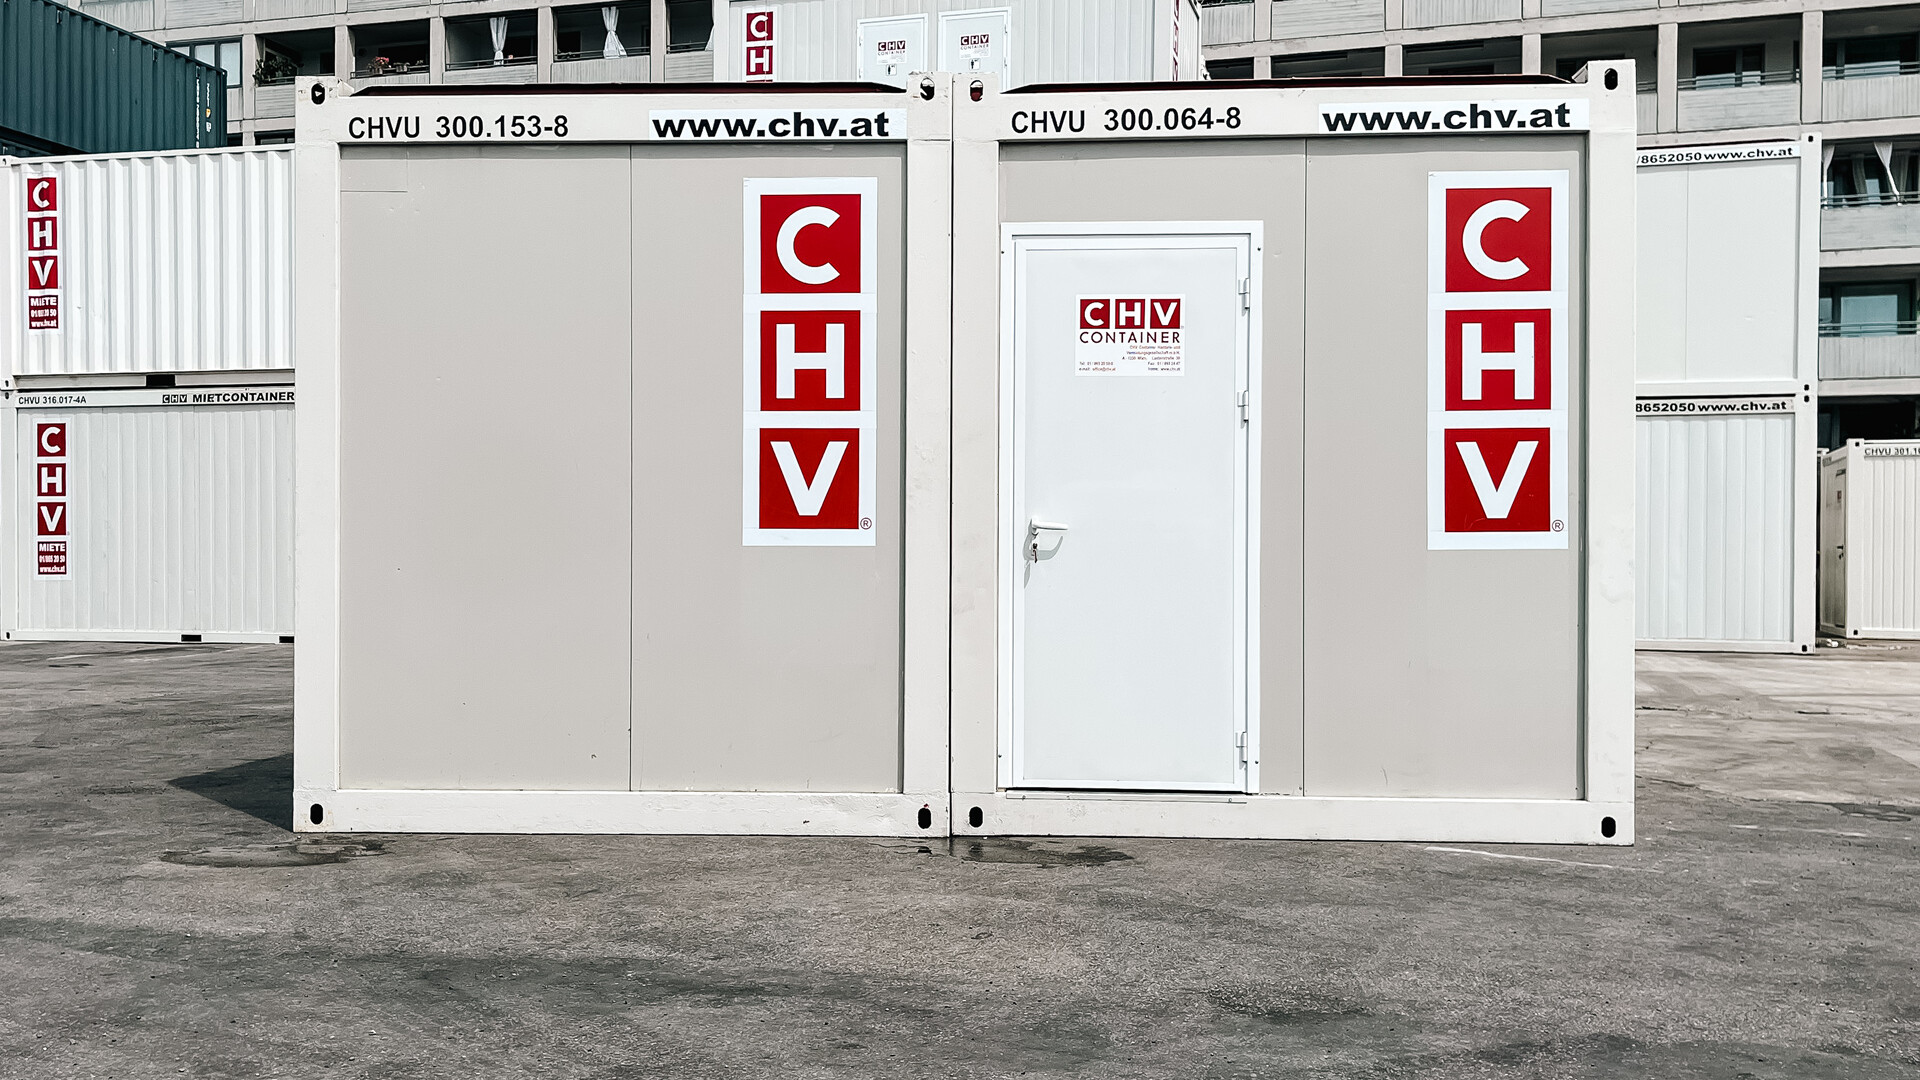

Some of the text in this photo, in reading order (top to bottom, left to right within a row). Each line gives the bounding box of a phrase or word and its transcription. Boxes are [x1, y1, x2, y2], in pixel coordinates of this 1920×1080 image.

[749, 14, 770, 73] CH
[878, 40, 906, 51] CHV
[961, 35, 989, 45] CHV
[348, 114, 569, 139] CHVU 300.153-8
[651, 110, 889, 138] www.chv.at
[1011, 106, 1242, 134] CHVU 300.064-8
[1321, 103, 1571, 132] www.chv.at
[1703, 147, 1794, 161] www.chv.at
[31, 180, 56, 287] CHV
[30, 296, 57, 307] MIETE
[1082, 300, 1179, 328] CHV
[1079, 331, 1180, 344] CONTAINER
[769, 205, 850, 516] CHV
[1455, 198, 1540, 520] CHV
[18, 395, 87, 405] CHVU 316.017-4A
[162, 391, 295, 403] CHV MIETCONTAINER
[1635, 401, 1787, 413] 8652050 www.chv.at
[1864, 447, 1892, 456] CHVU
[39, 425, 65, 532] CHV
[38, 543, 66, 552] MIETE
